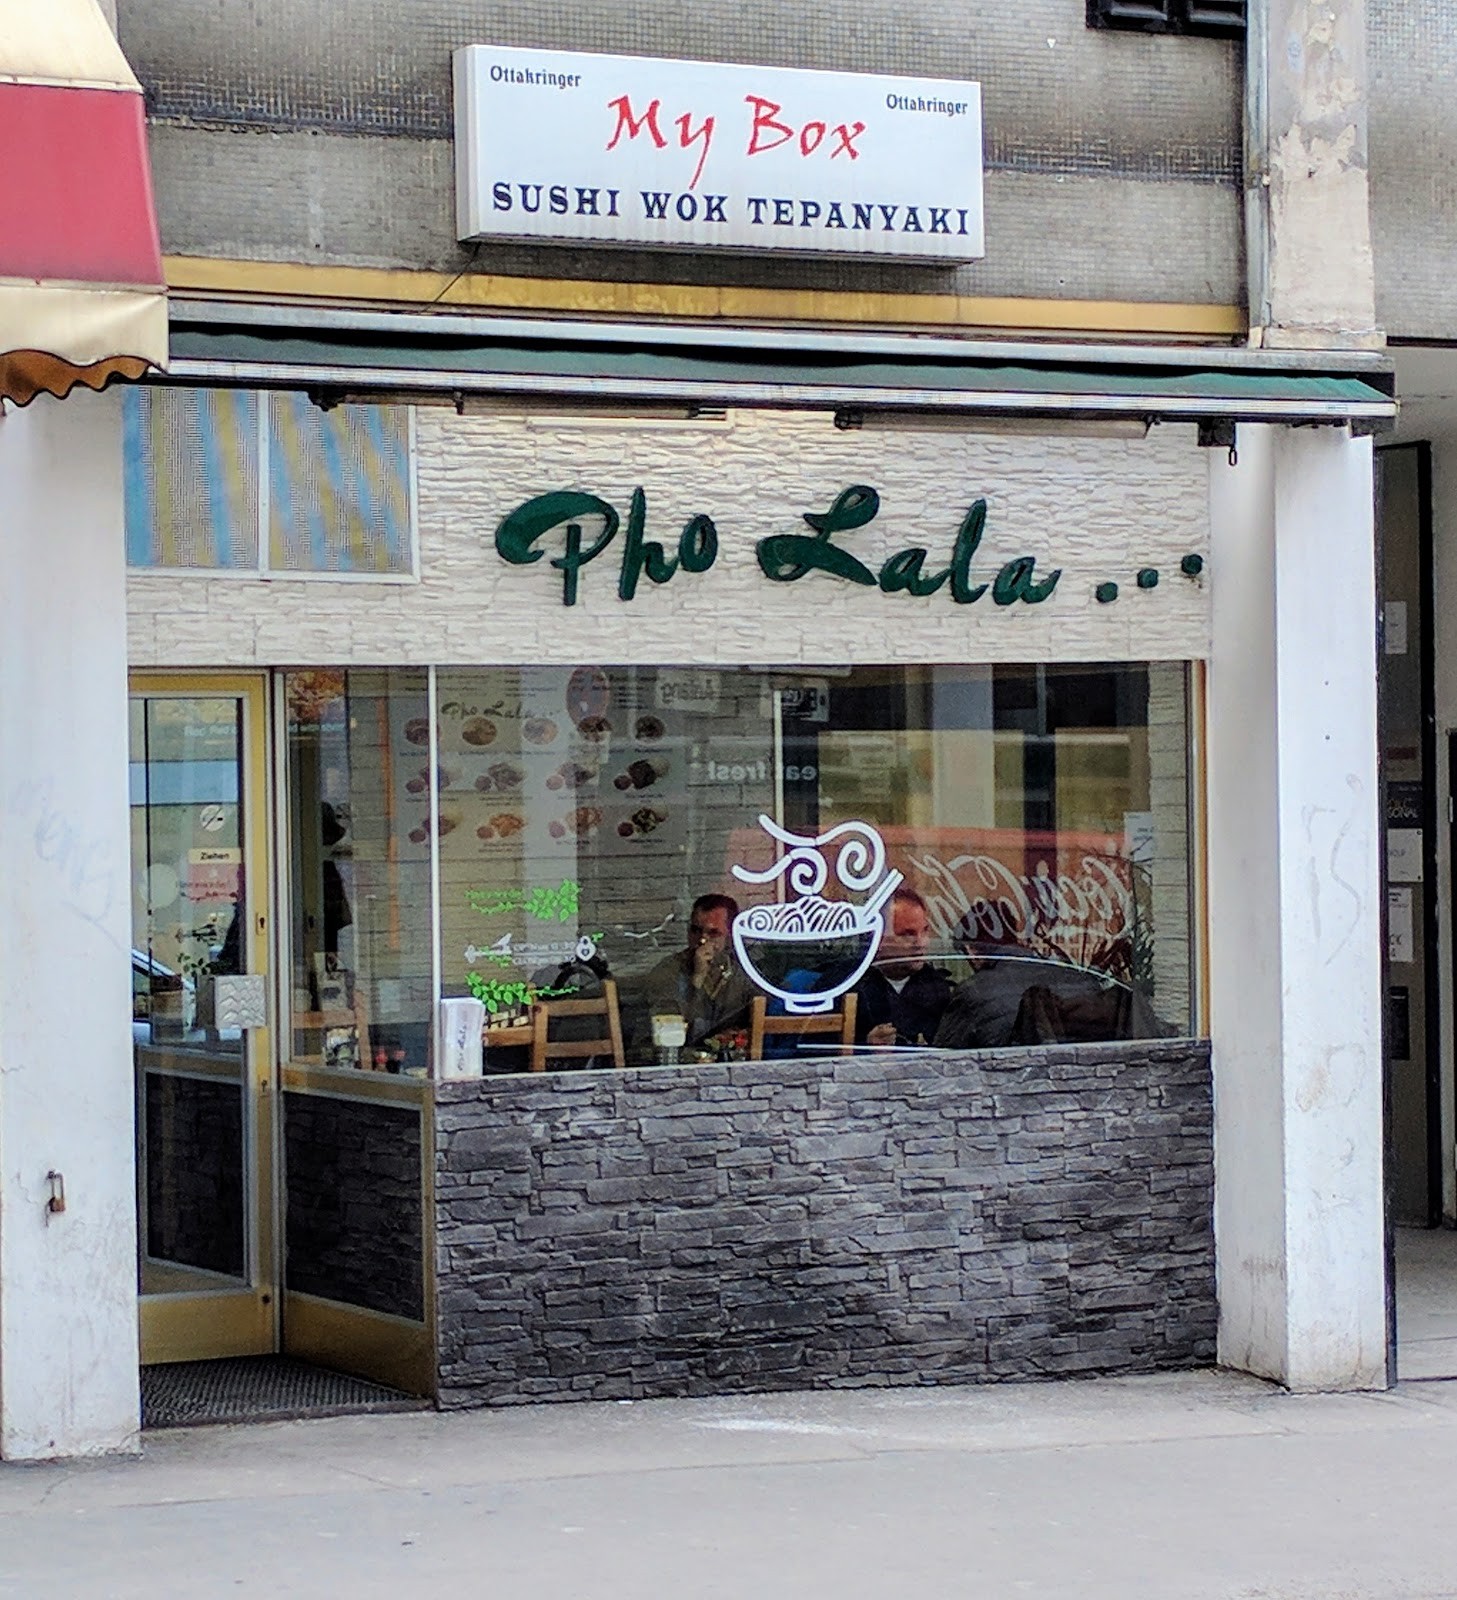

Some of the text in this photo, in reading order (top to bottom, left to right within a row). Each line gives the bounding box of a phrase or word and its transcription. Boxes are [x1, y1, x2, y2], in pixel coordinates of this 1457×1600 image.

[490, 65, 581, 89] Ottakringer
[885, 93, 968, 117] Ottakringer
[606, 95, 866, 190] My Box
[492, 182, 969, 236] SUSHI WOK TEPANYAKI
[495, 485, 719, 606] Pho
[755, 484, 1062, 605] Lala
